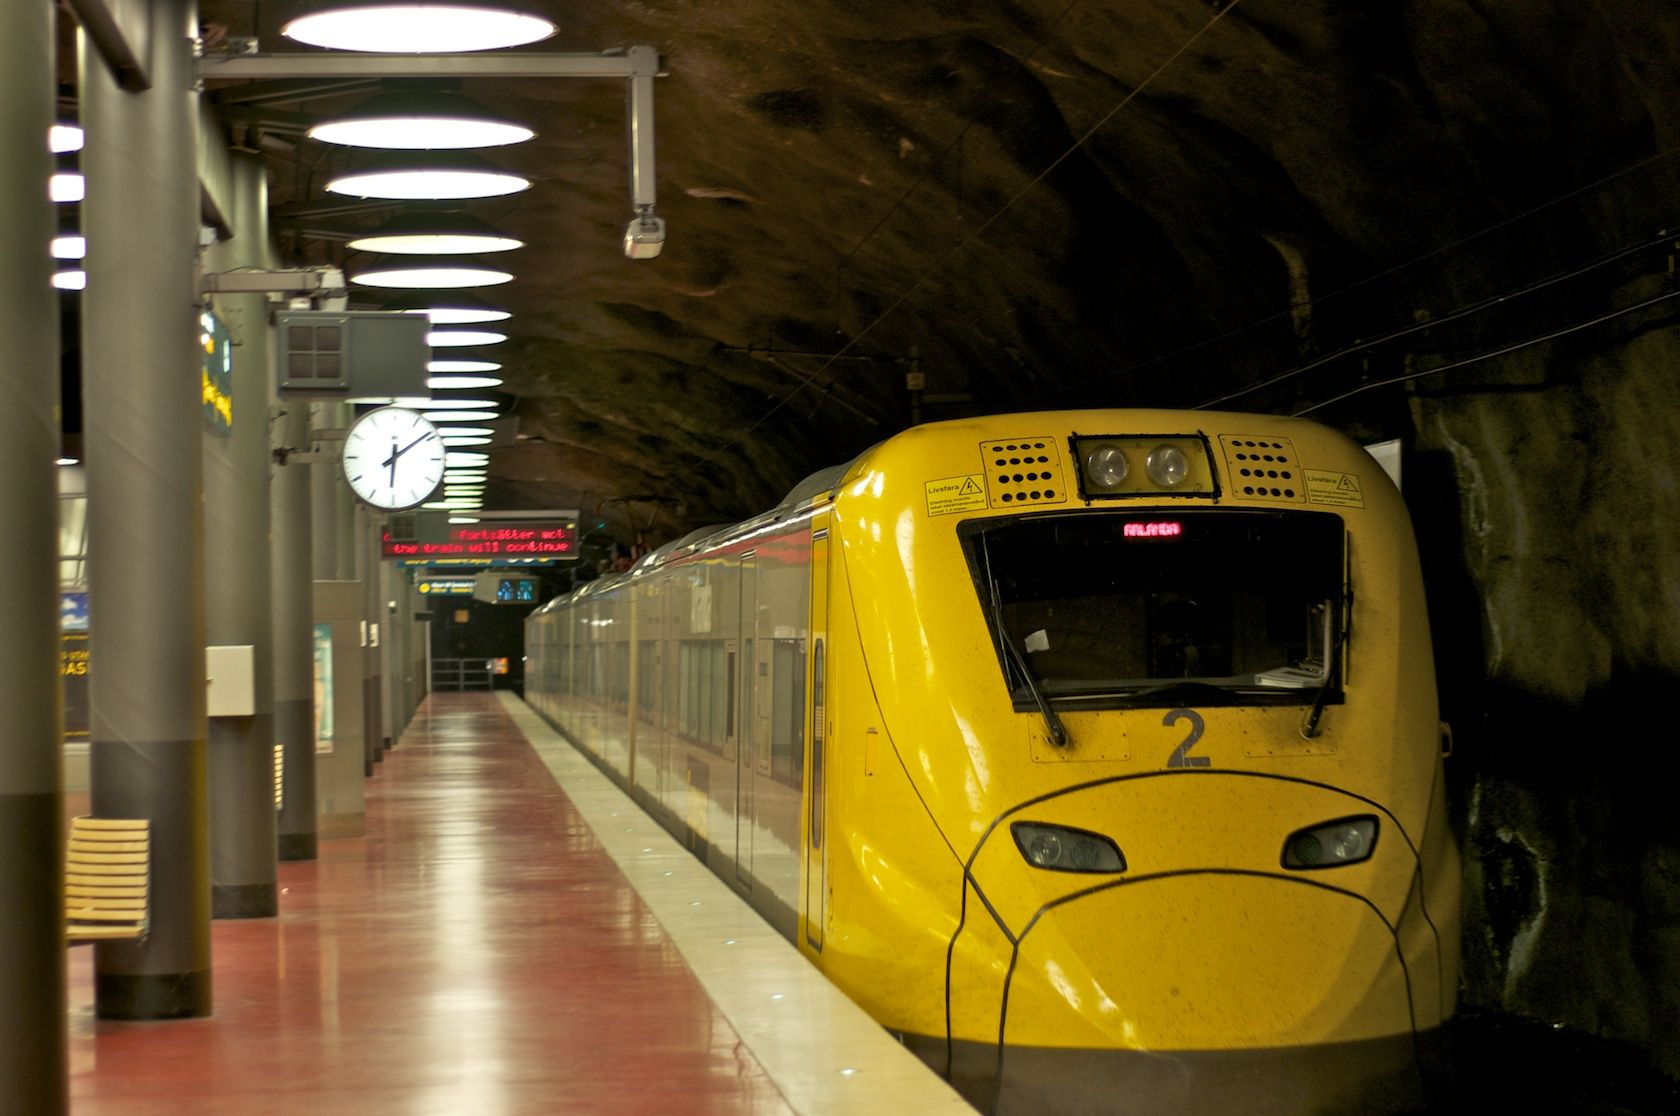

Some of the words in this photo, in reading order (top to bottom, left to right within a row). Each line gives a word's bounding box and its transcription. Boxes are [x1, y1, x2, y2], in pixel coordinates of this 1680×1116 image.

[928, 484, 960, 494] Livsfara
[393, 543, 418, 554] the
[423, 543, 464, 554] train
[468, 541, 499, 553] will
[505, 541, 569, 553] continue
[1162, 707, 1211, 769] 2
